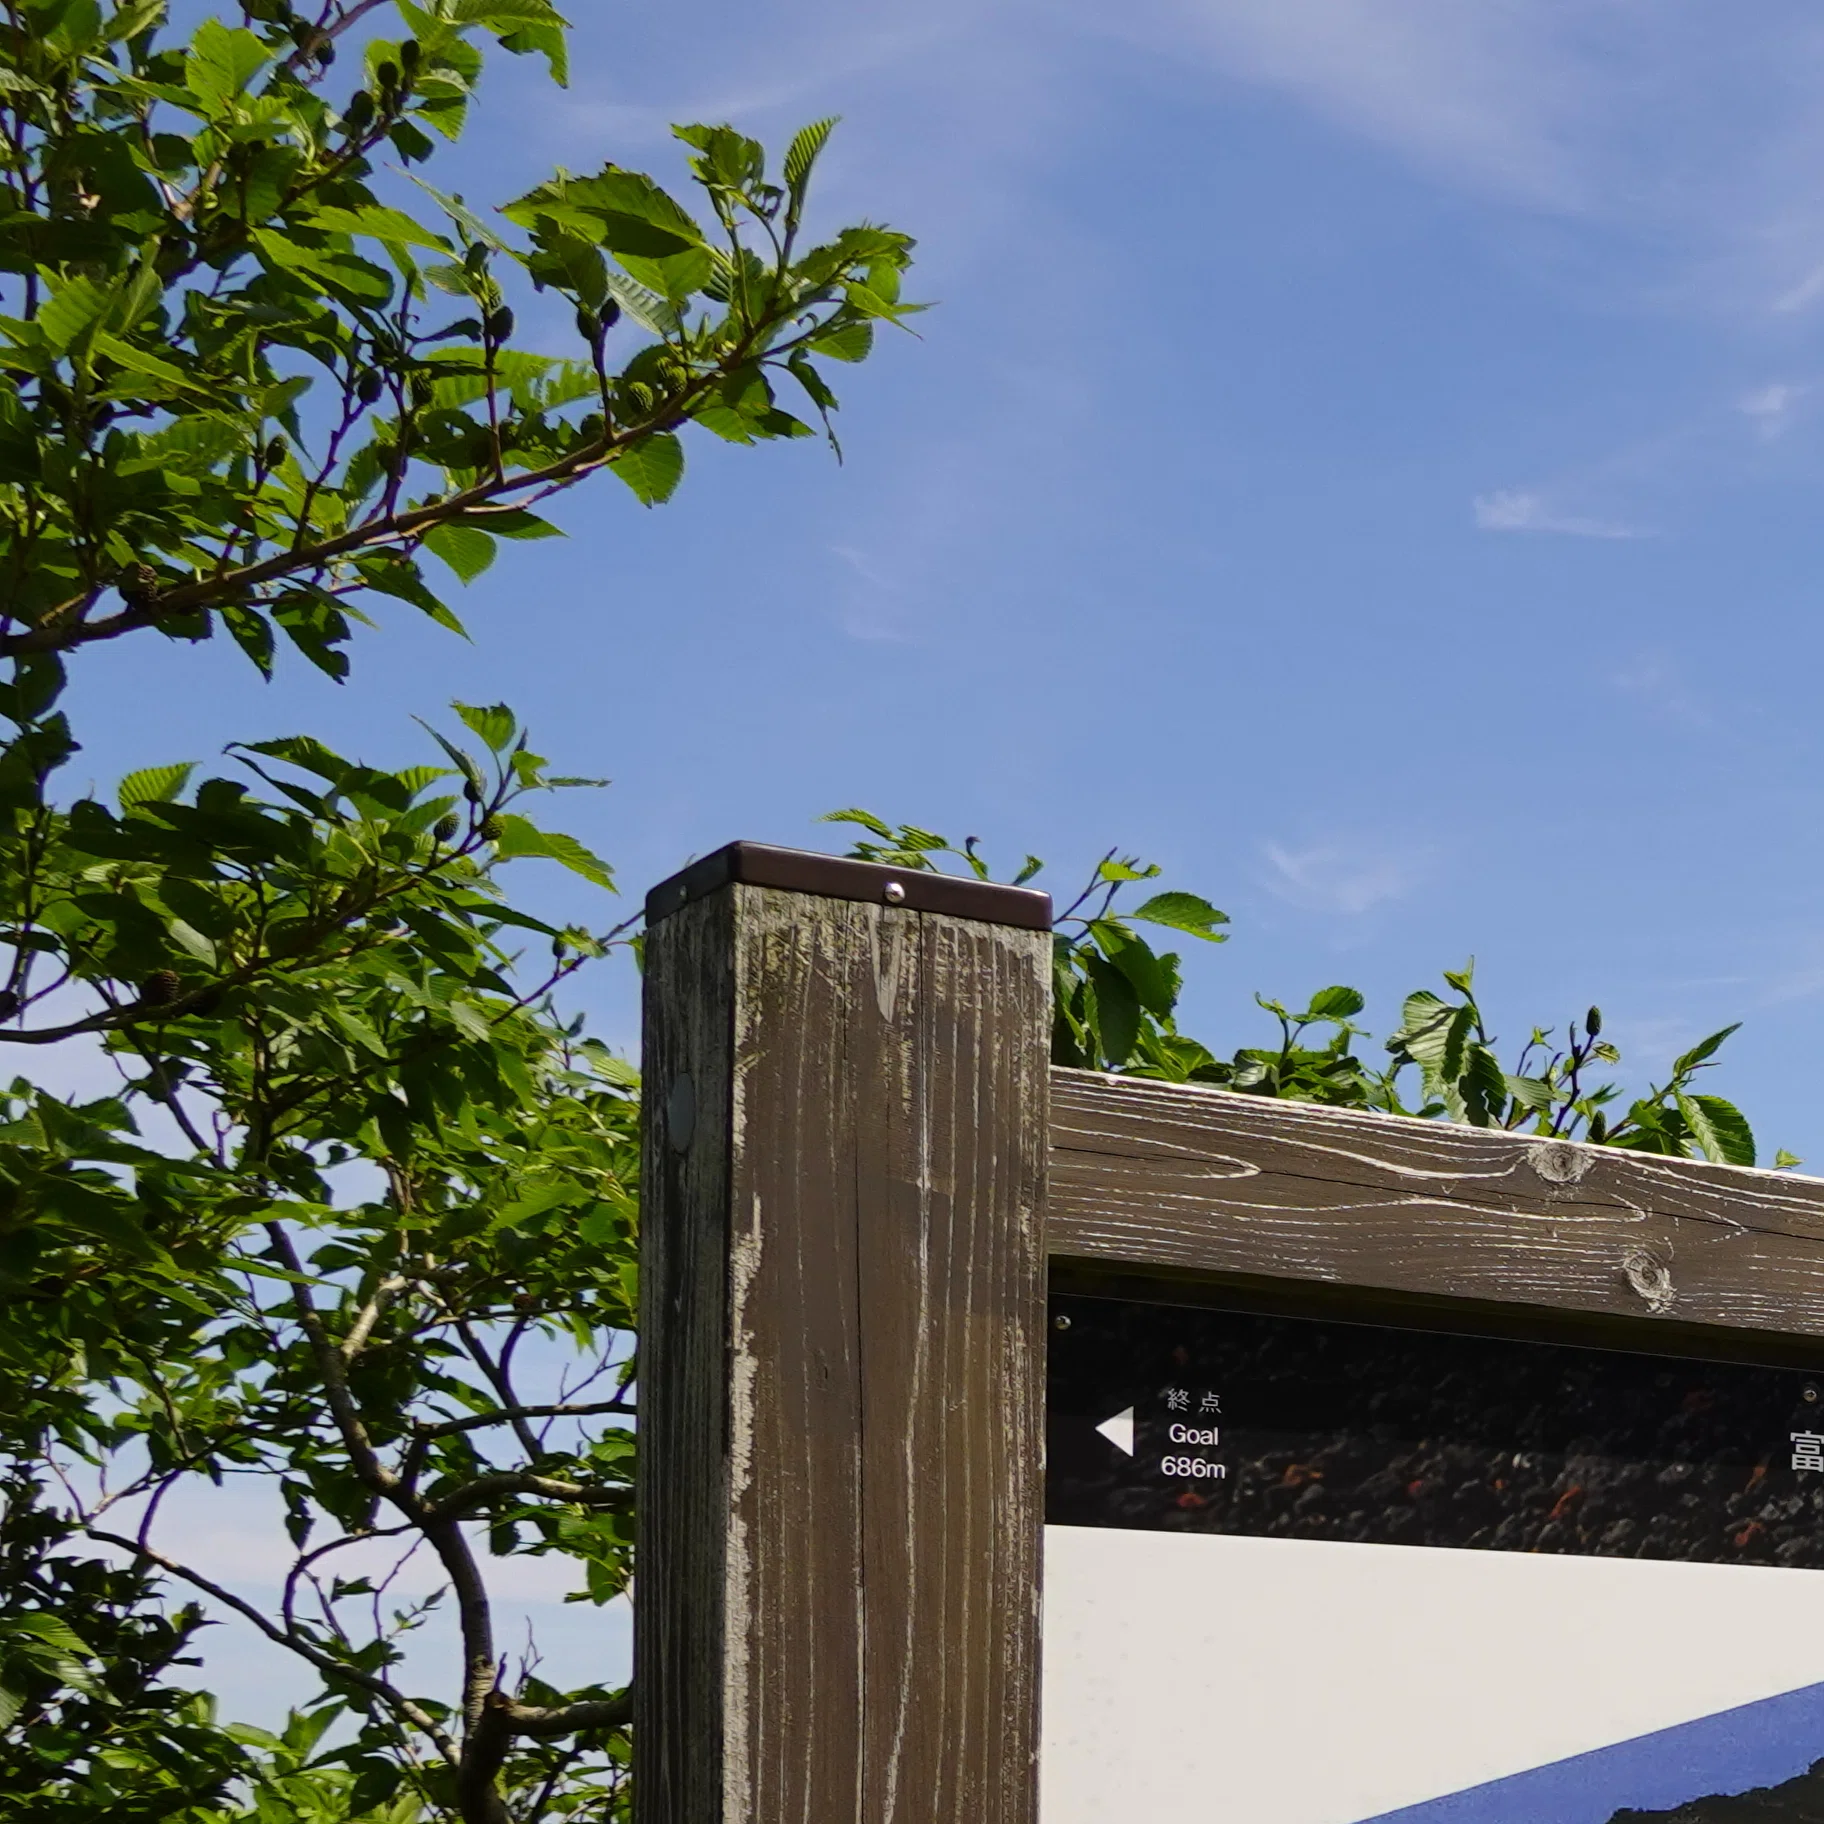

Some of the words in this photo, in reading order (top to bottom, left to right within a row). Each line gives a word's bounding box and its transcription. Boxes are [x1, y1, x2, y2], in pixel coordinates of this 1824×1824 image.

[1167, 1388, 1222, 1413] 終点
[1169, 1423, 1218, 1446] Goal
[1161, 1455, 1226, 1479] 686m
